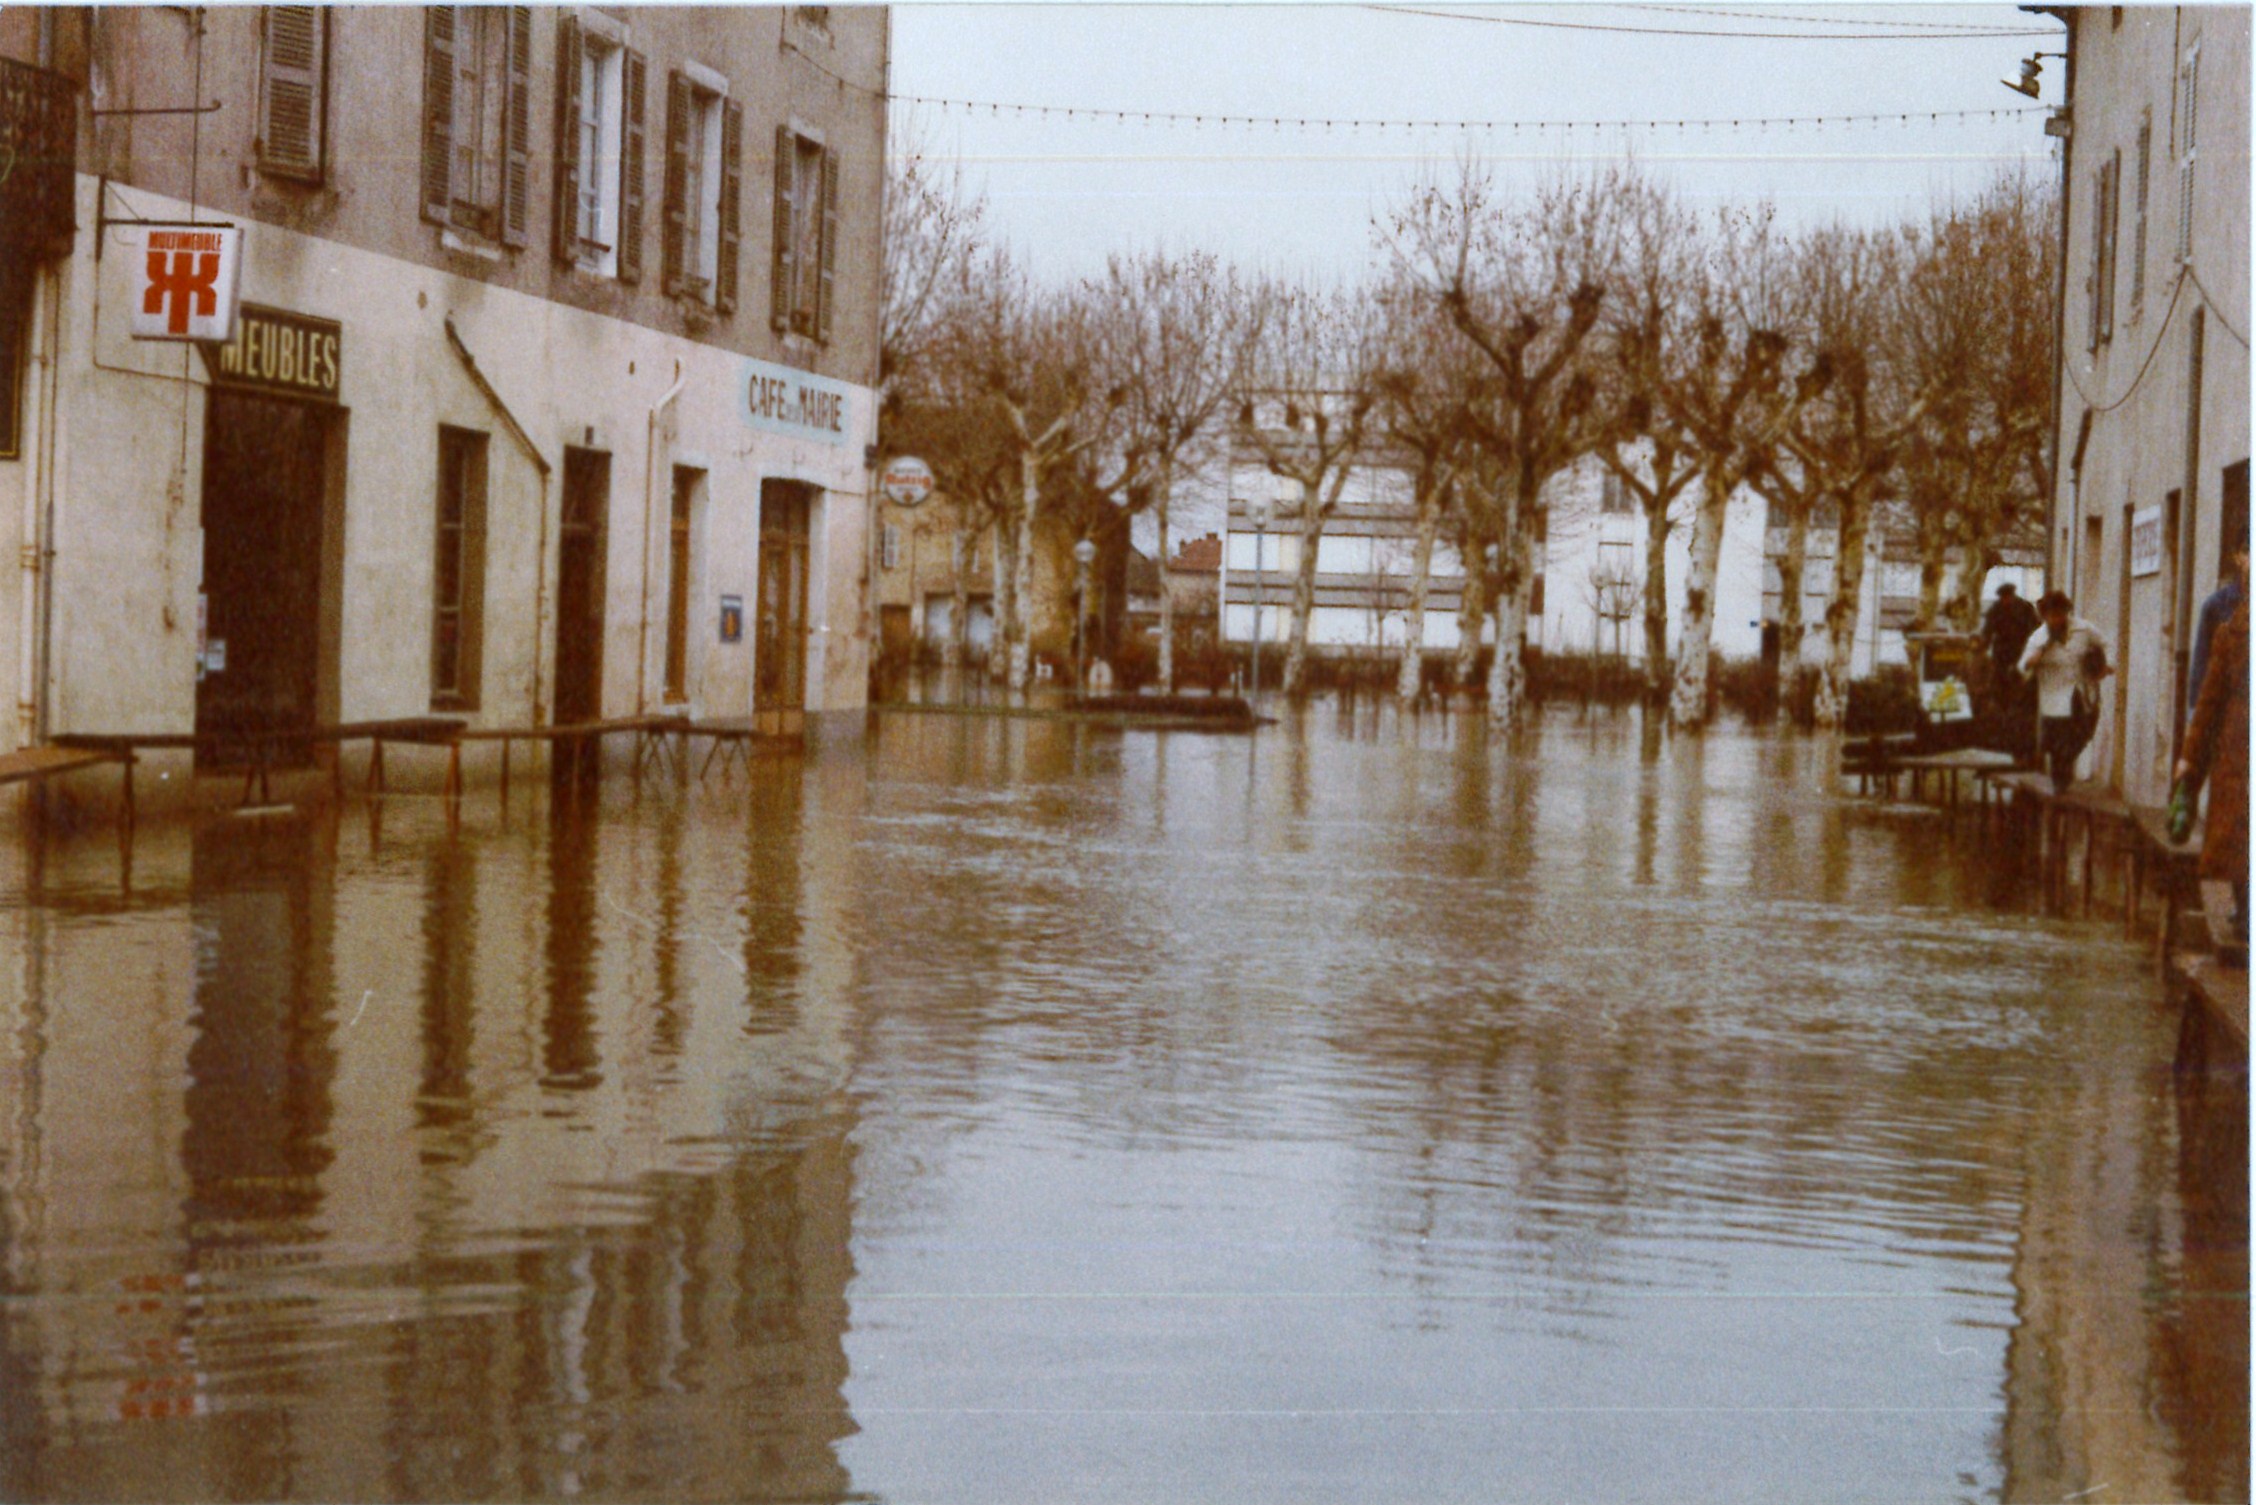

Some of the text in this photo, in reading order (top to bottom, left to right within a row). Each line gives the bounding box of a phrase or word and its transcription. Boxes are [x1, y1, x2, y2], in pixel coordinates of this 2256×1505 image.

[220, 316, 337, 390] MEUBLES
[749, 373, 786, 421] CAFE
[799, 384, 842, 432] MAIRIE
